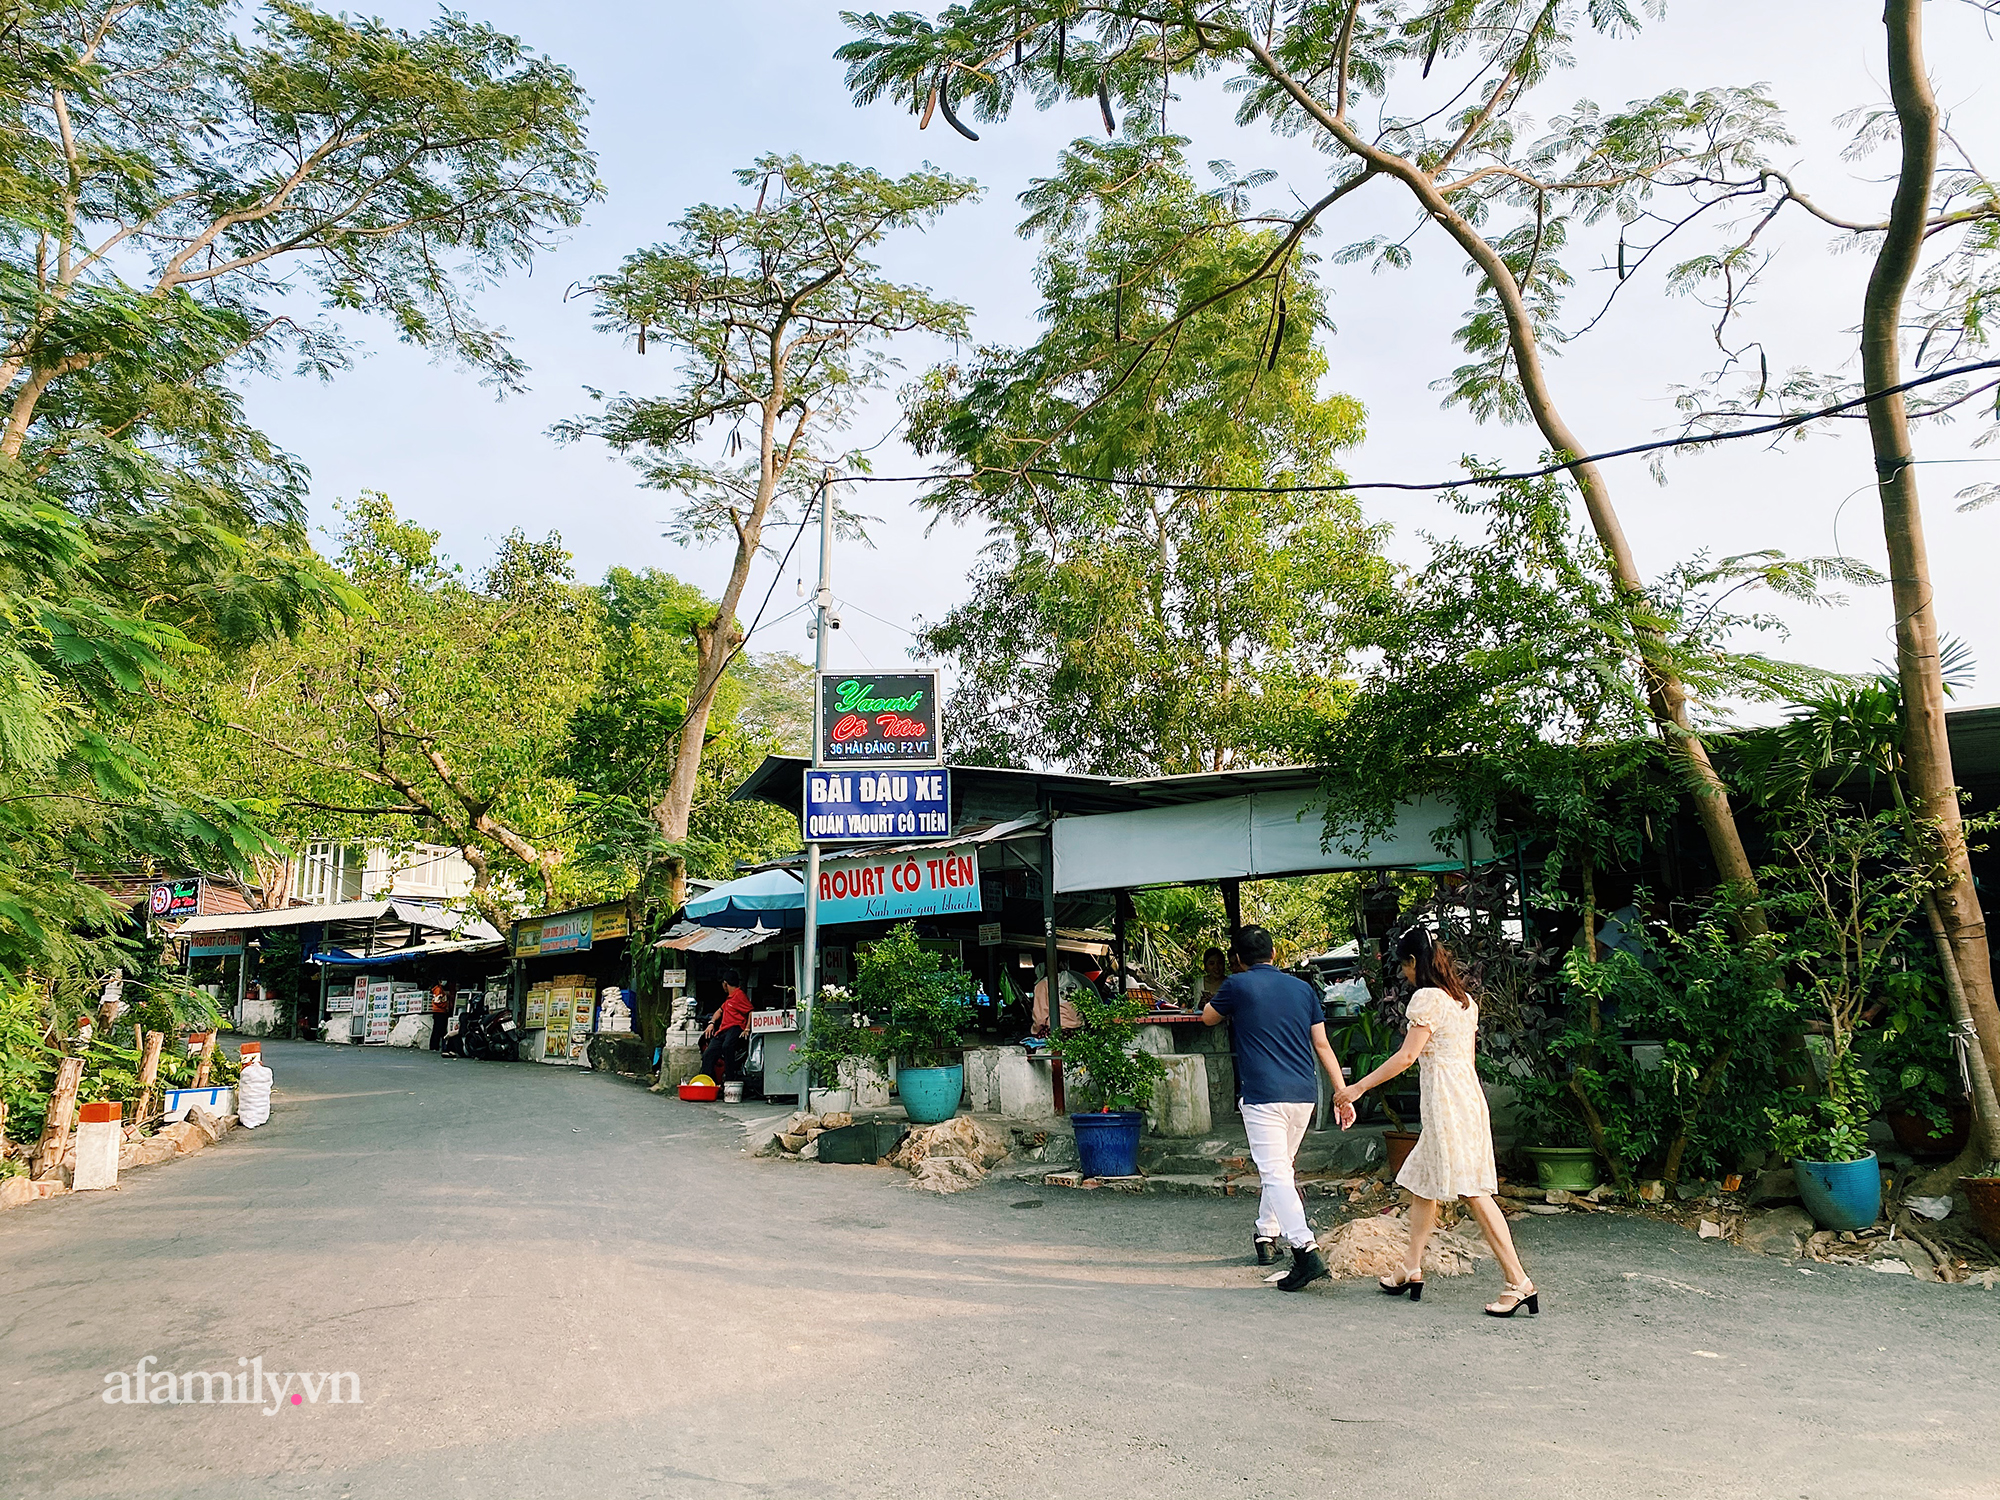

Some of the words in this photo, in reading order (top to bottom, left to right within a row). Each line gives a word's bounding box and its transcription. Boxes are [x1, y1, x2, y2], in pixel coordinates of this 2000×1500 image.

[834, 680, 924, 712] Yaourt
[832, 714, 868, 741] Cô
[876, 714, 926, 738] Tiên
[830, 743, 843, 754] 36
[811, 774, 852, 803] BÃI
[859, 772, 908, 807] ĐẬU
[915, 776, 943, 801] XE
[809, 812, 844, 837] QUÁN
[847, 813, 895, 834] YAOURT
[897, 810, 915, 833] CÔ
[918, 809, 946, 832] TIÊN
[819, 866, 885, 900] AOURT
[892, 855, 921, 892] CÔ
[926, 850, 975, 890] TIÊN
[858, 899, 889, 918] Kính
[775, 1014, 794, 1026] NT
